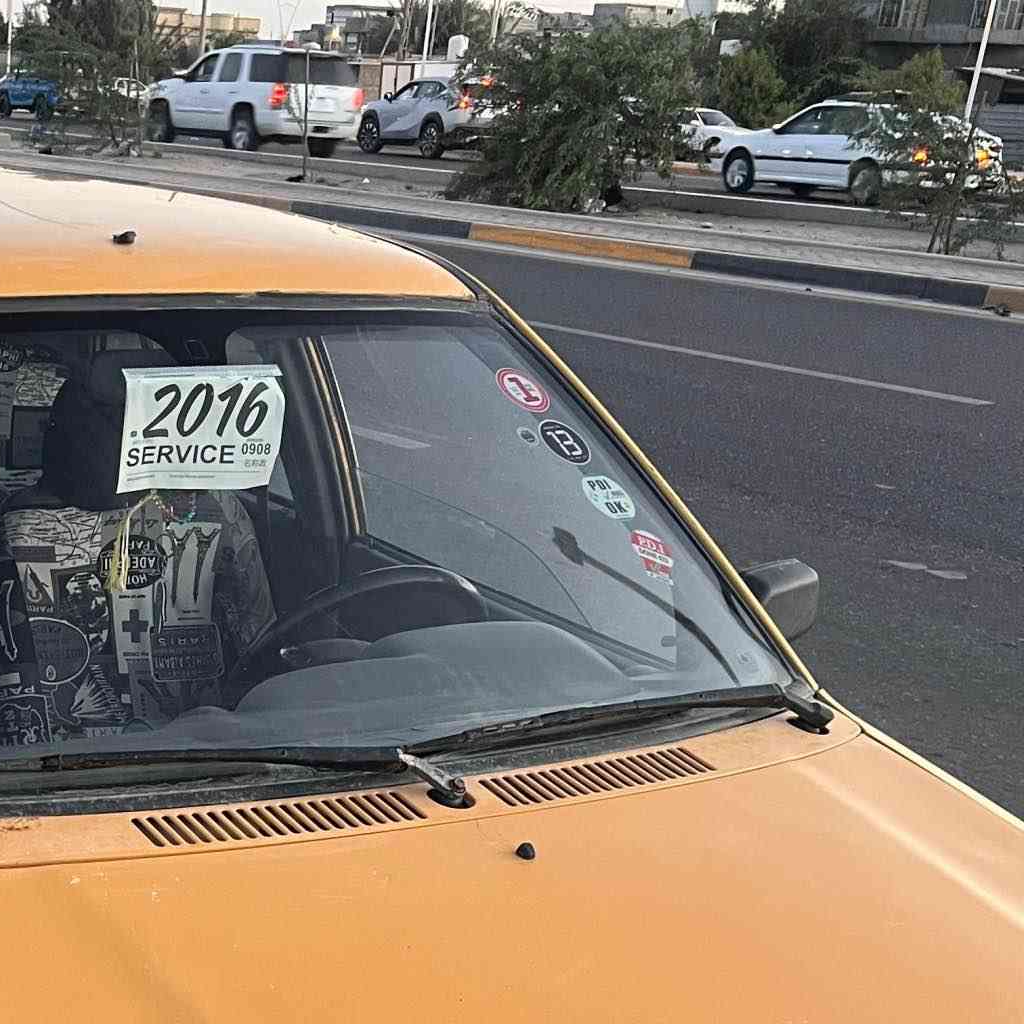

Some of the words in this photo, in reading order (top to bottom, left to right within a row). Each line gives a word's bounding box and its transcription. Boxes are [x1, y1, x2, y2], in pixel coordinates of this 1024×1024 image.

[143, 381, 269, 439] 2016
[126, 444, 235, 467] SERVICE
[241, 442, 271, 456] 0908
[587, 479, 611, 491] PDI
[605, 501, 627, 514] OK
[104, 556, 156, 570] ADEI
